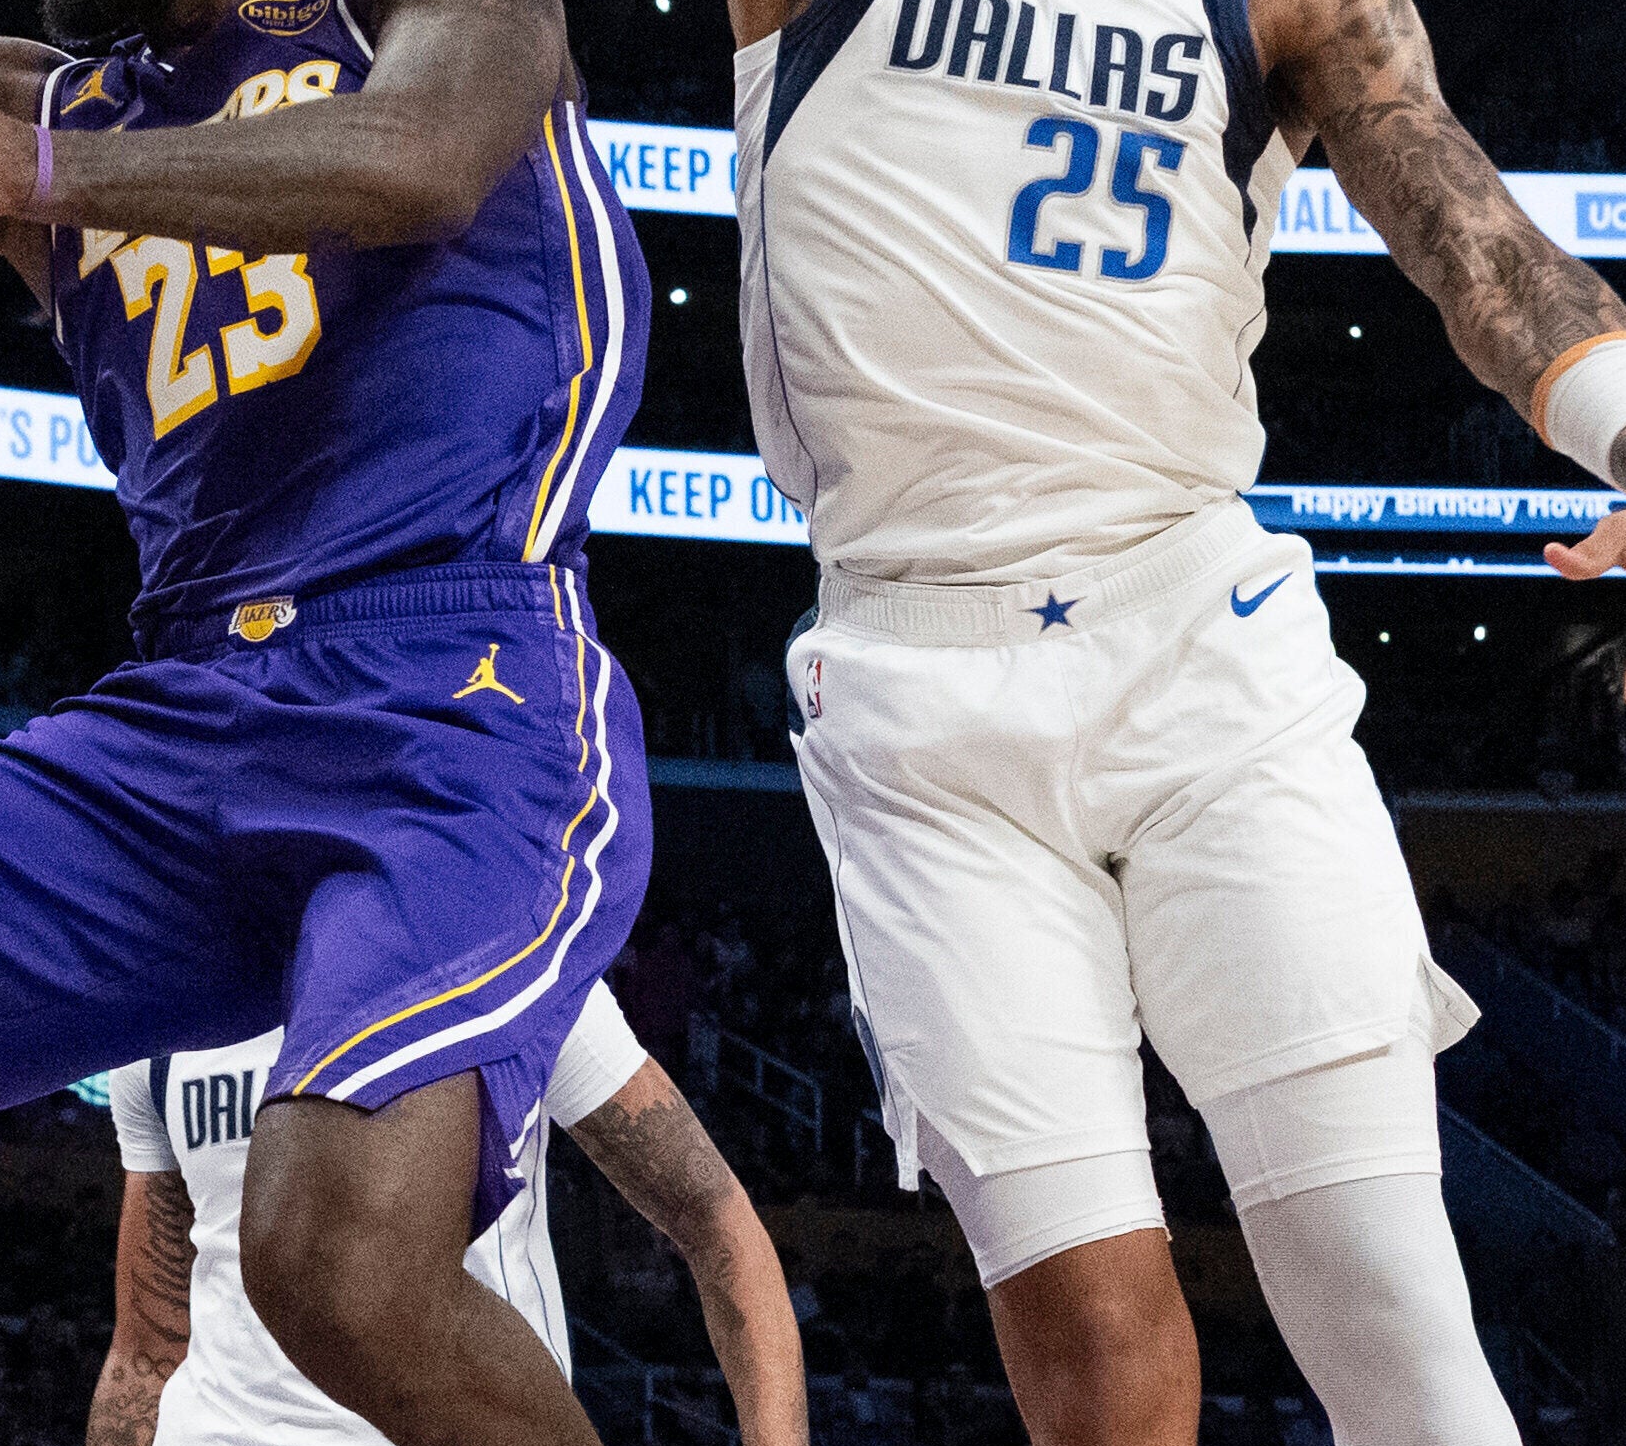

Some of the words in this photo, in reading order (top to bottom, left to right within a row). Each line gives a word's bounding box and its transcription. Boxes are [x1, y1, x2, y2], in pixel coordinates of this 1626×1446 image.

[609, 142, 711, 194] KEEP
[1008, 117, 1188, 281] 25
[111, 235, 321, 439] 23
[629, 467, 733, 520] KEEP
[1291, 491, 1386, 521] Happy
[1395, 491, 1522, 523] Birthday
[228, 600, 298, 636] LAKERS
[182, 1070, 257, 1151] DAL
